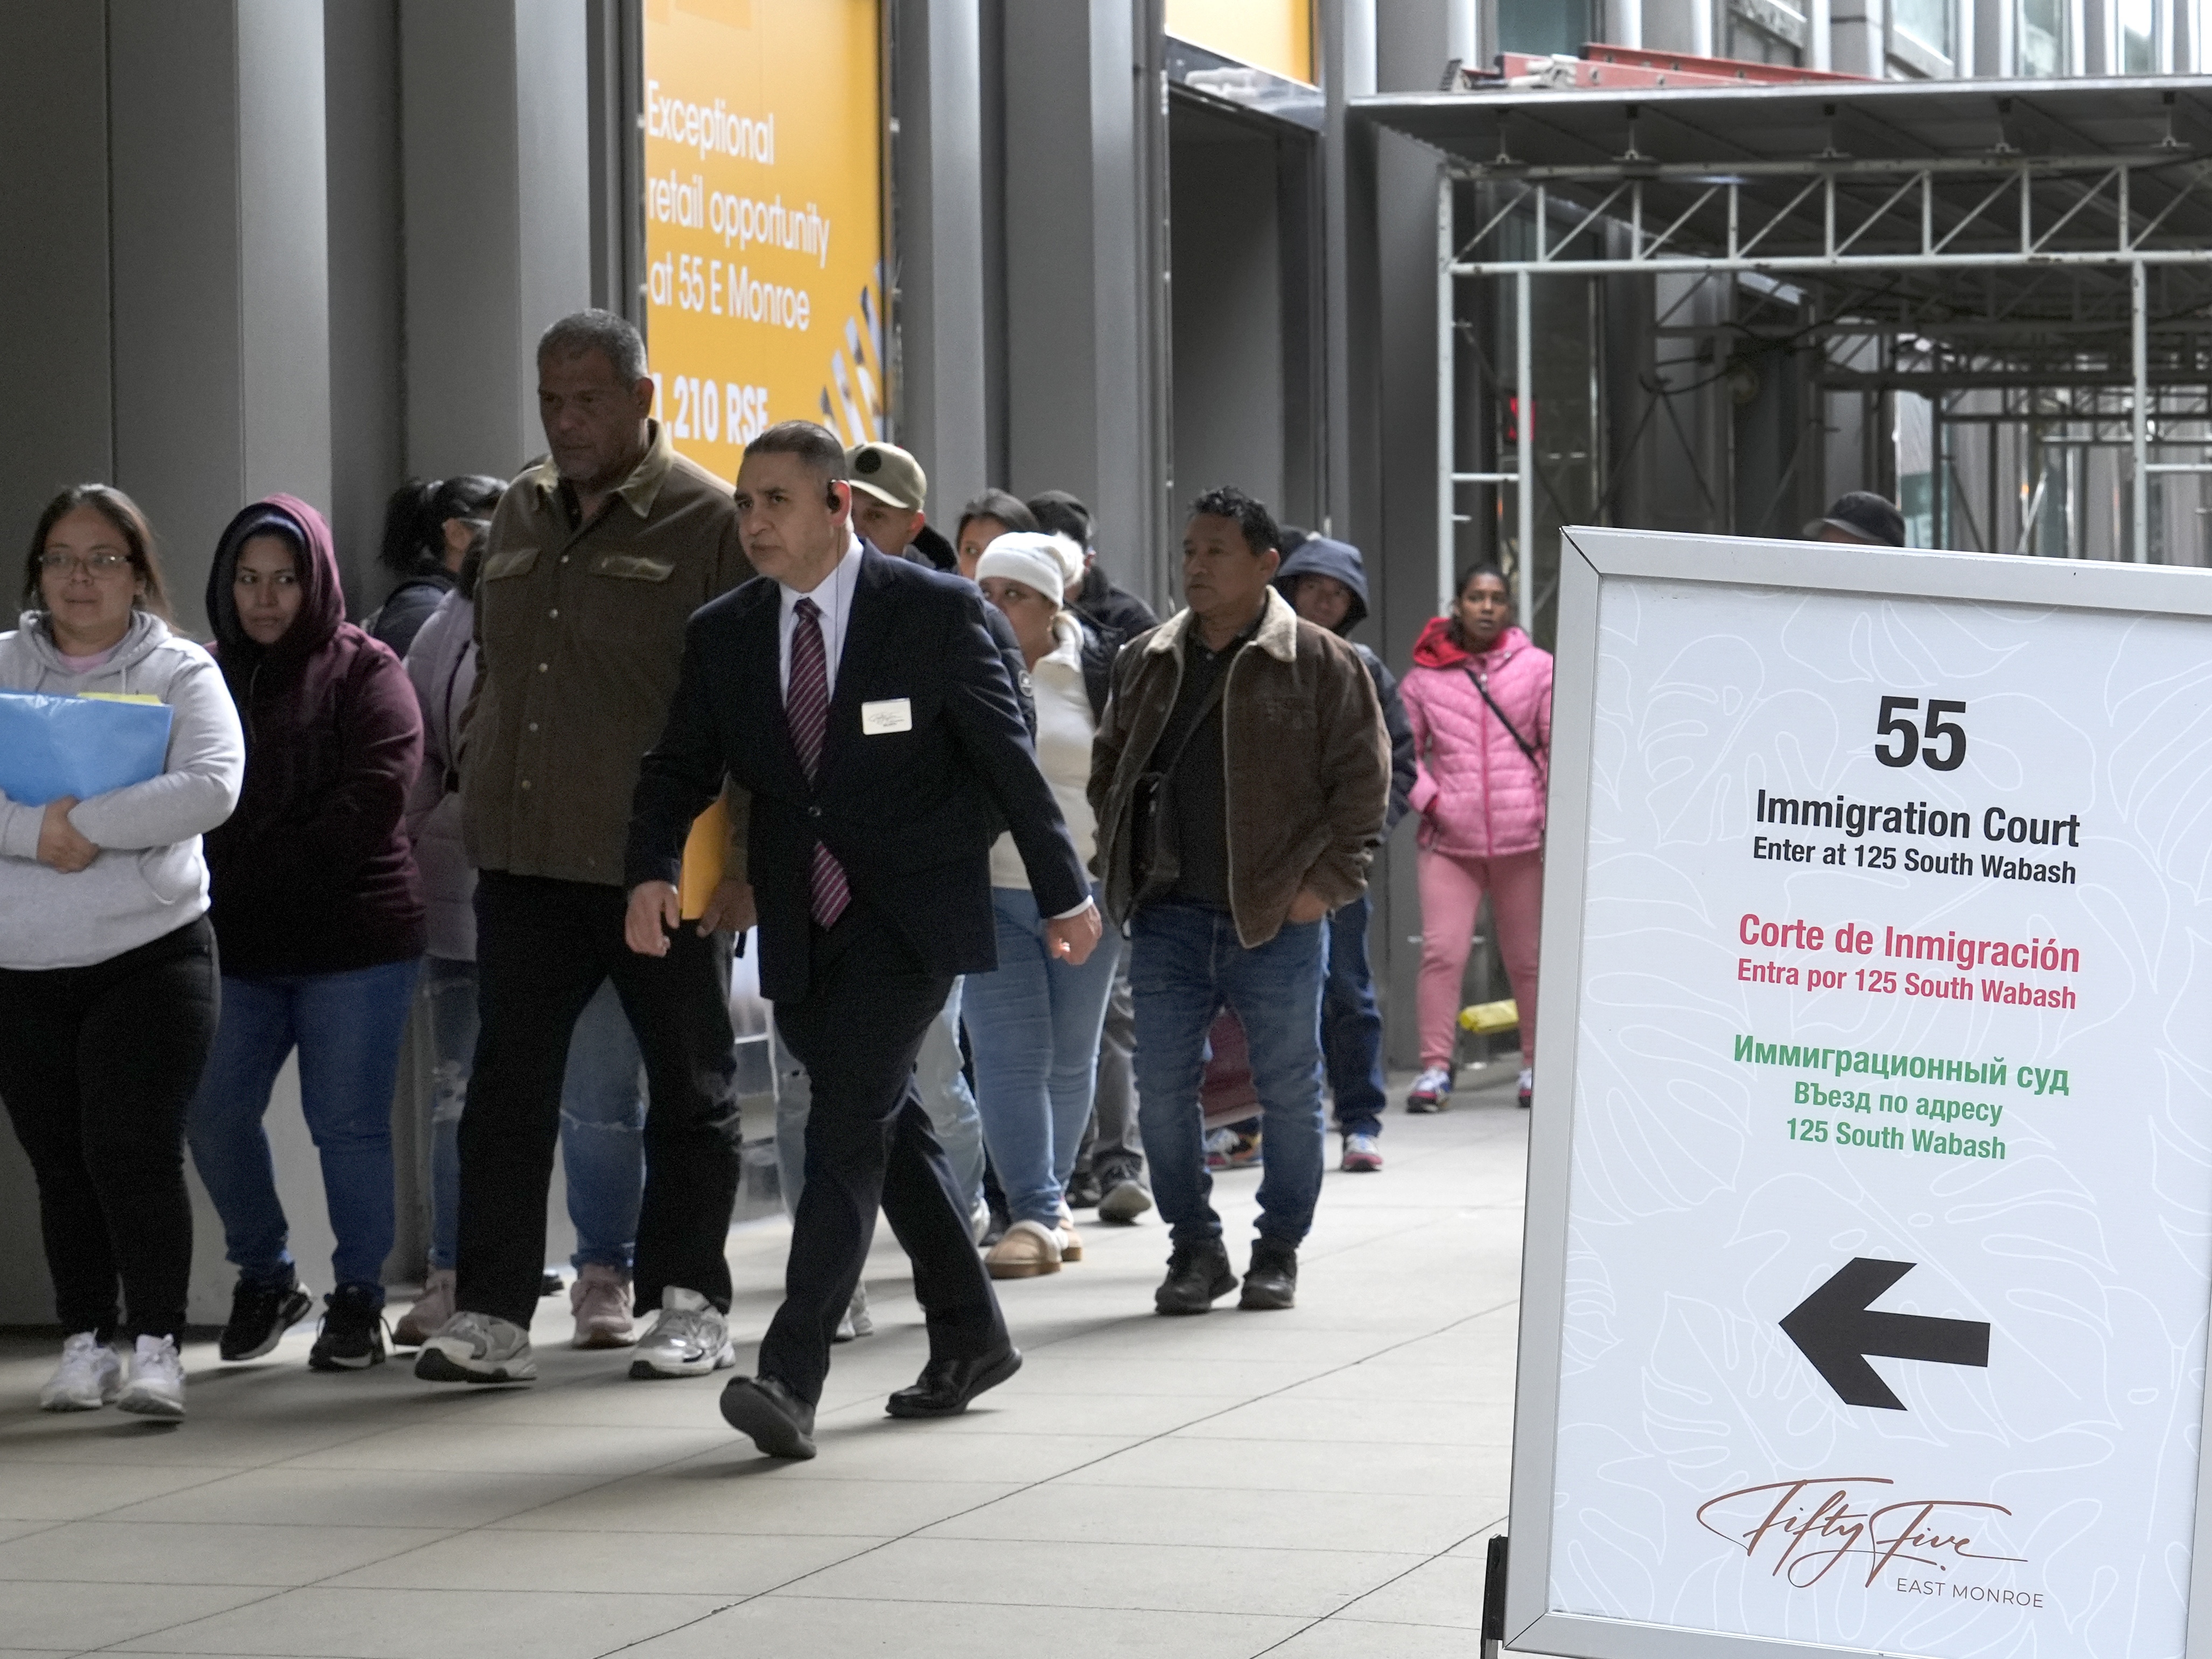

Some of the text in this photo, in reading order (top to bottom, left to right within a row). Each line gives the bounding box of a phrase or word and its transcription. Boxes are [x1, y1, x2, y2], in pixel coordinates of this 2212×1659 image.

[648, 80, 774, 165] Exceptional
[649, 171, 829, 268] retail opportunity
[650, 253, 810, 331] at 55 E Monroe
[1875, 696, 1966, 771] 55
[1756, 789, 2080, 847] Immigration Court
[1754, 836, 2076, 884] Enter at 125 South Wabash
[1740, 914, 2080, 972] Corte de Inmigración
[1738, 958, 2076, 1009] Entra por 125 South Wabash
[1734, 1034, 2069, 1096] Иммиграционный суд
[1787, 1118, 2006, 1159] 125 South Wabash
[1879, 1094, 1908, 1114] по
[1915, 1097, 2003, 1127] адресу
[1696, 1477, 2028, 1588] Fifty Five
[1897, 1578, 2044, 1608] EAST MONROE
